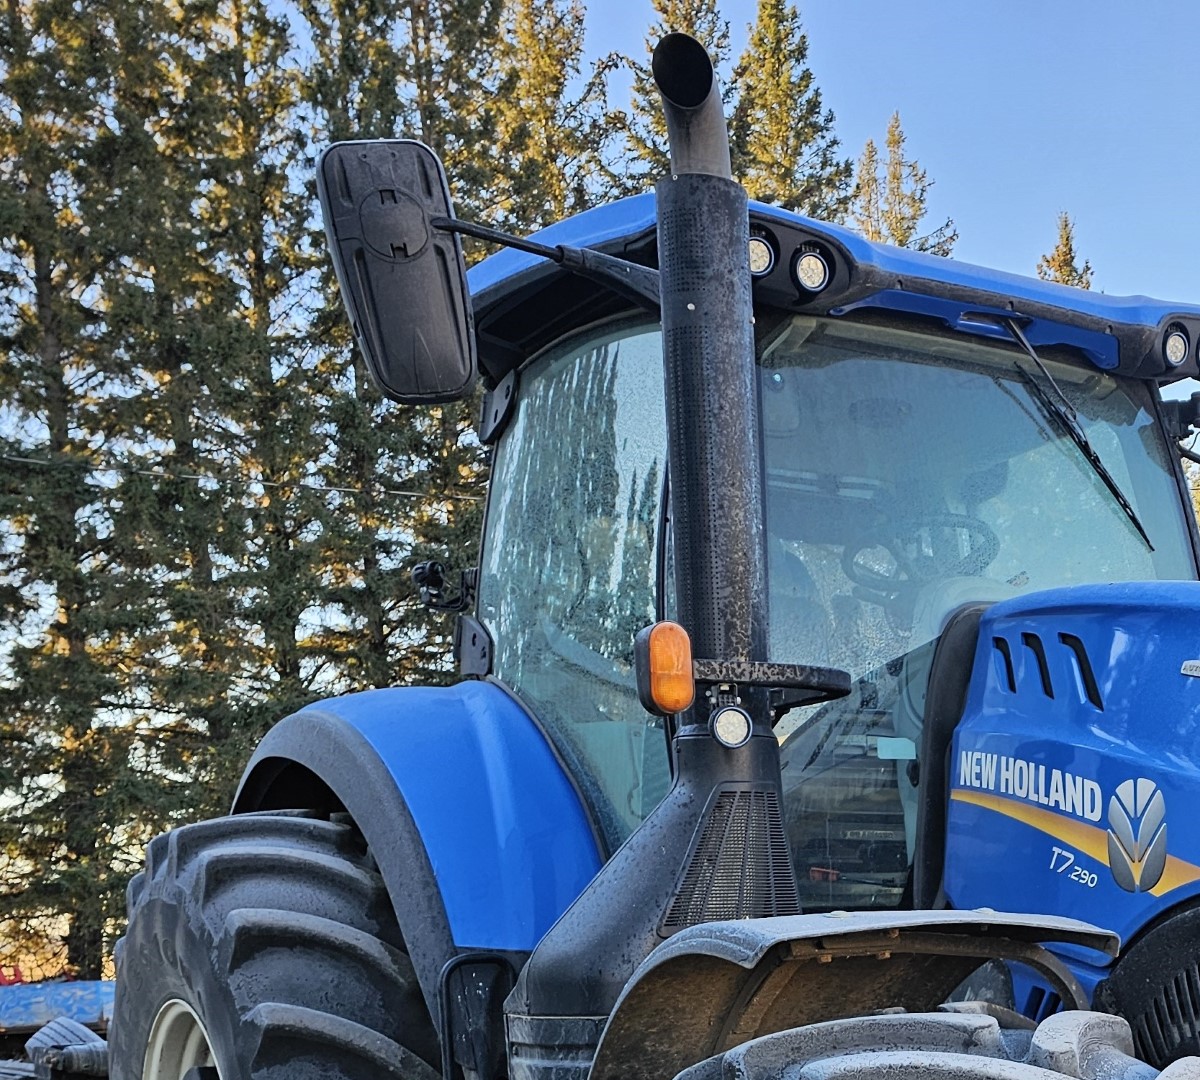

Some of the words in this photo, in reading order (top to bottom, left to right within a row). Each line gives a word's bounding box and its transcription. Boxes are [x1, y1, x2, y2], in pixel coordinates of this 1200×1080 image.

[959, 750, 998, 791] NEW
[1000, 755, 1103, 822] HOLLAND
[1050, 846, 1098, 888] T7.290
